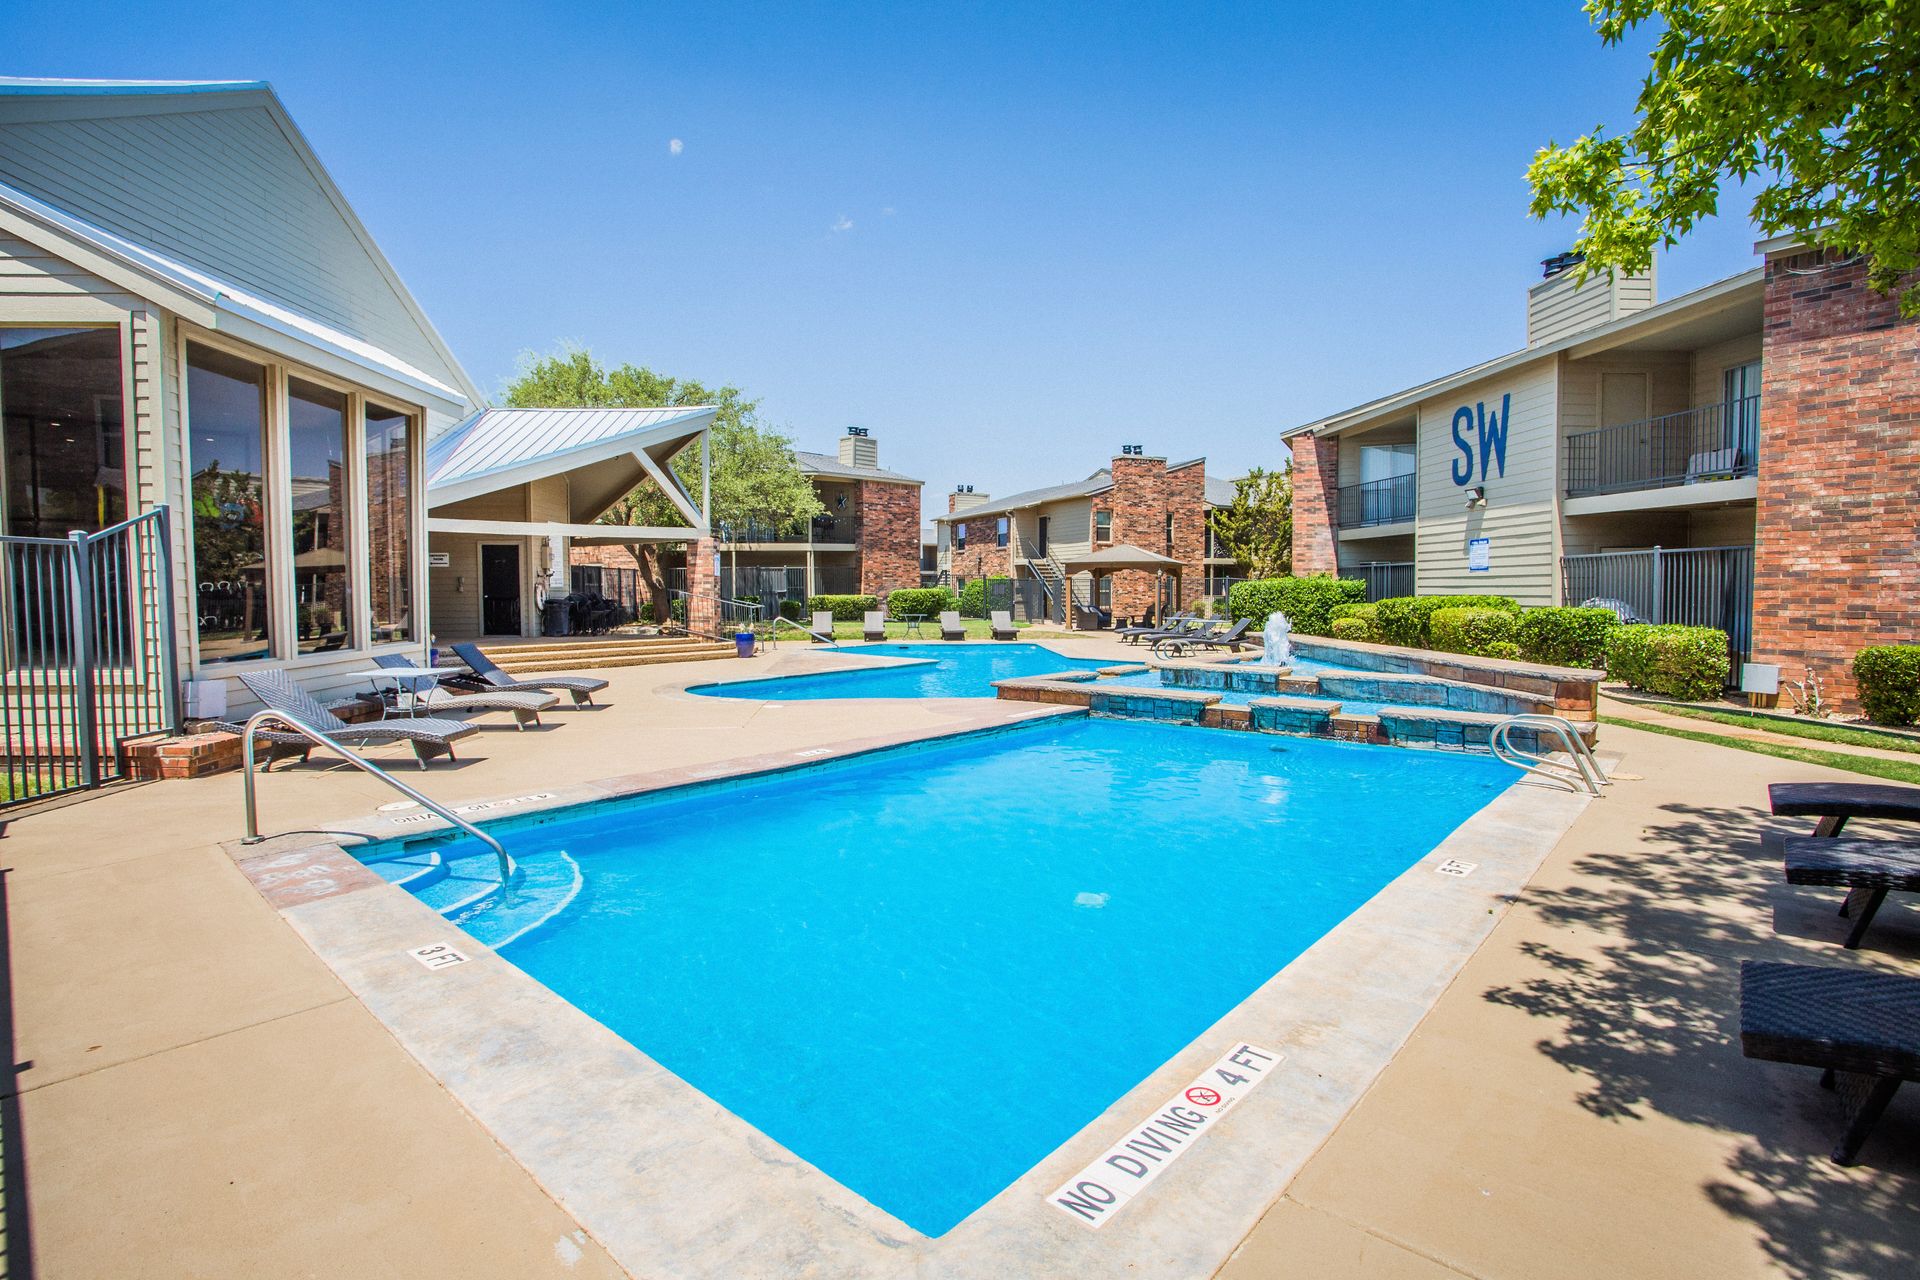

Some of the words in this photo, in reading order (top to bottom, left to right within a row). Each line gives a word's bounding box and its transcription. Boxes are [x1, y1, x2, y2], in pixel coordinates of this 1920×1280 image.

[1452, 393, 1510, 486] SW
[1447, 860, 1473, 870] FT
[417, 946, 446, 956] 3
[426, 953, 465, 967] FT
[1228, 1045, 1273, 1072] FT
[1215, 1068, 1250, 1086] 4
[1105, 1106, 1208, 1179] DIVING
[1057, 1181, 1117, 1221] NO
